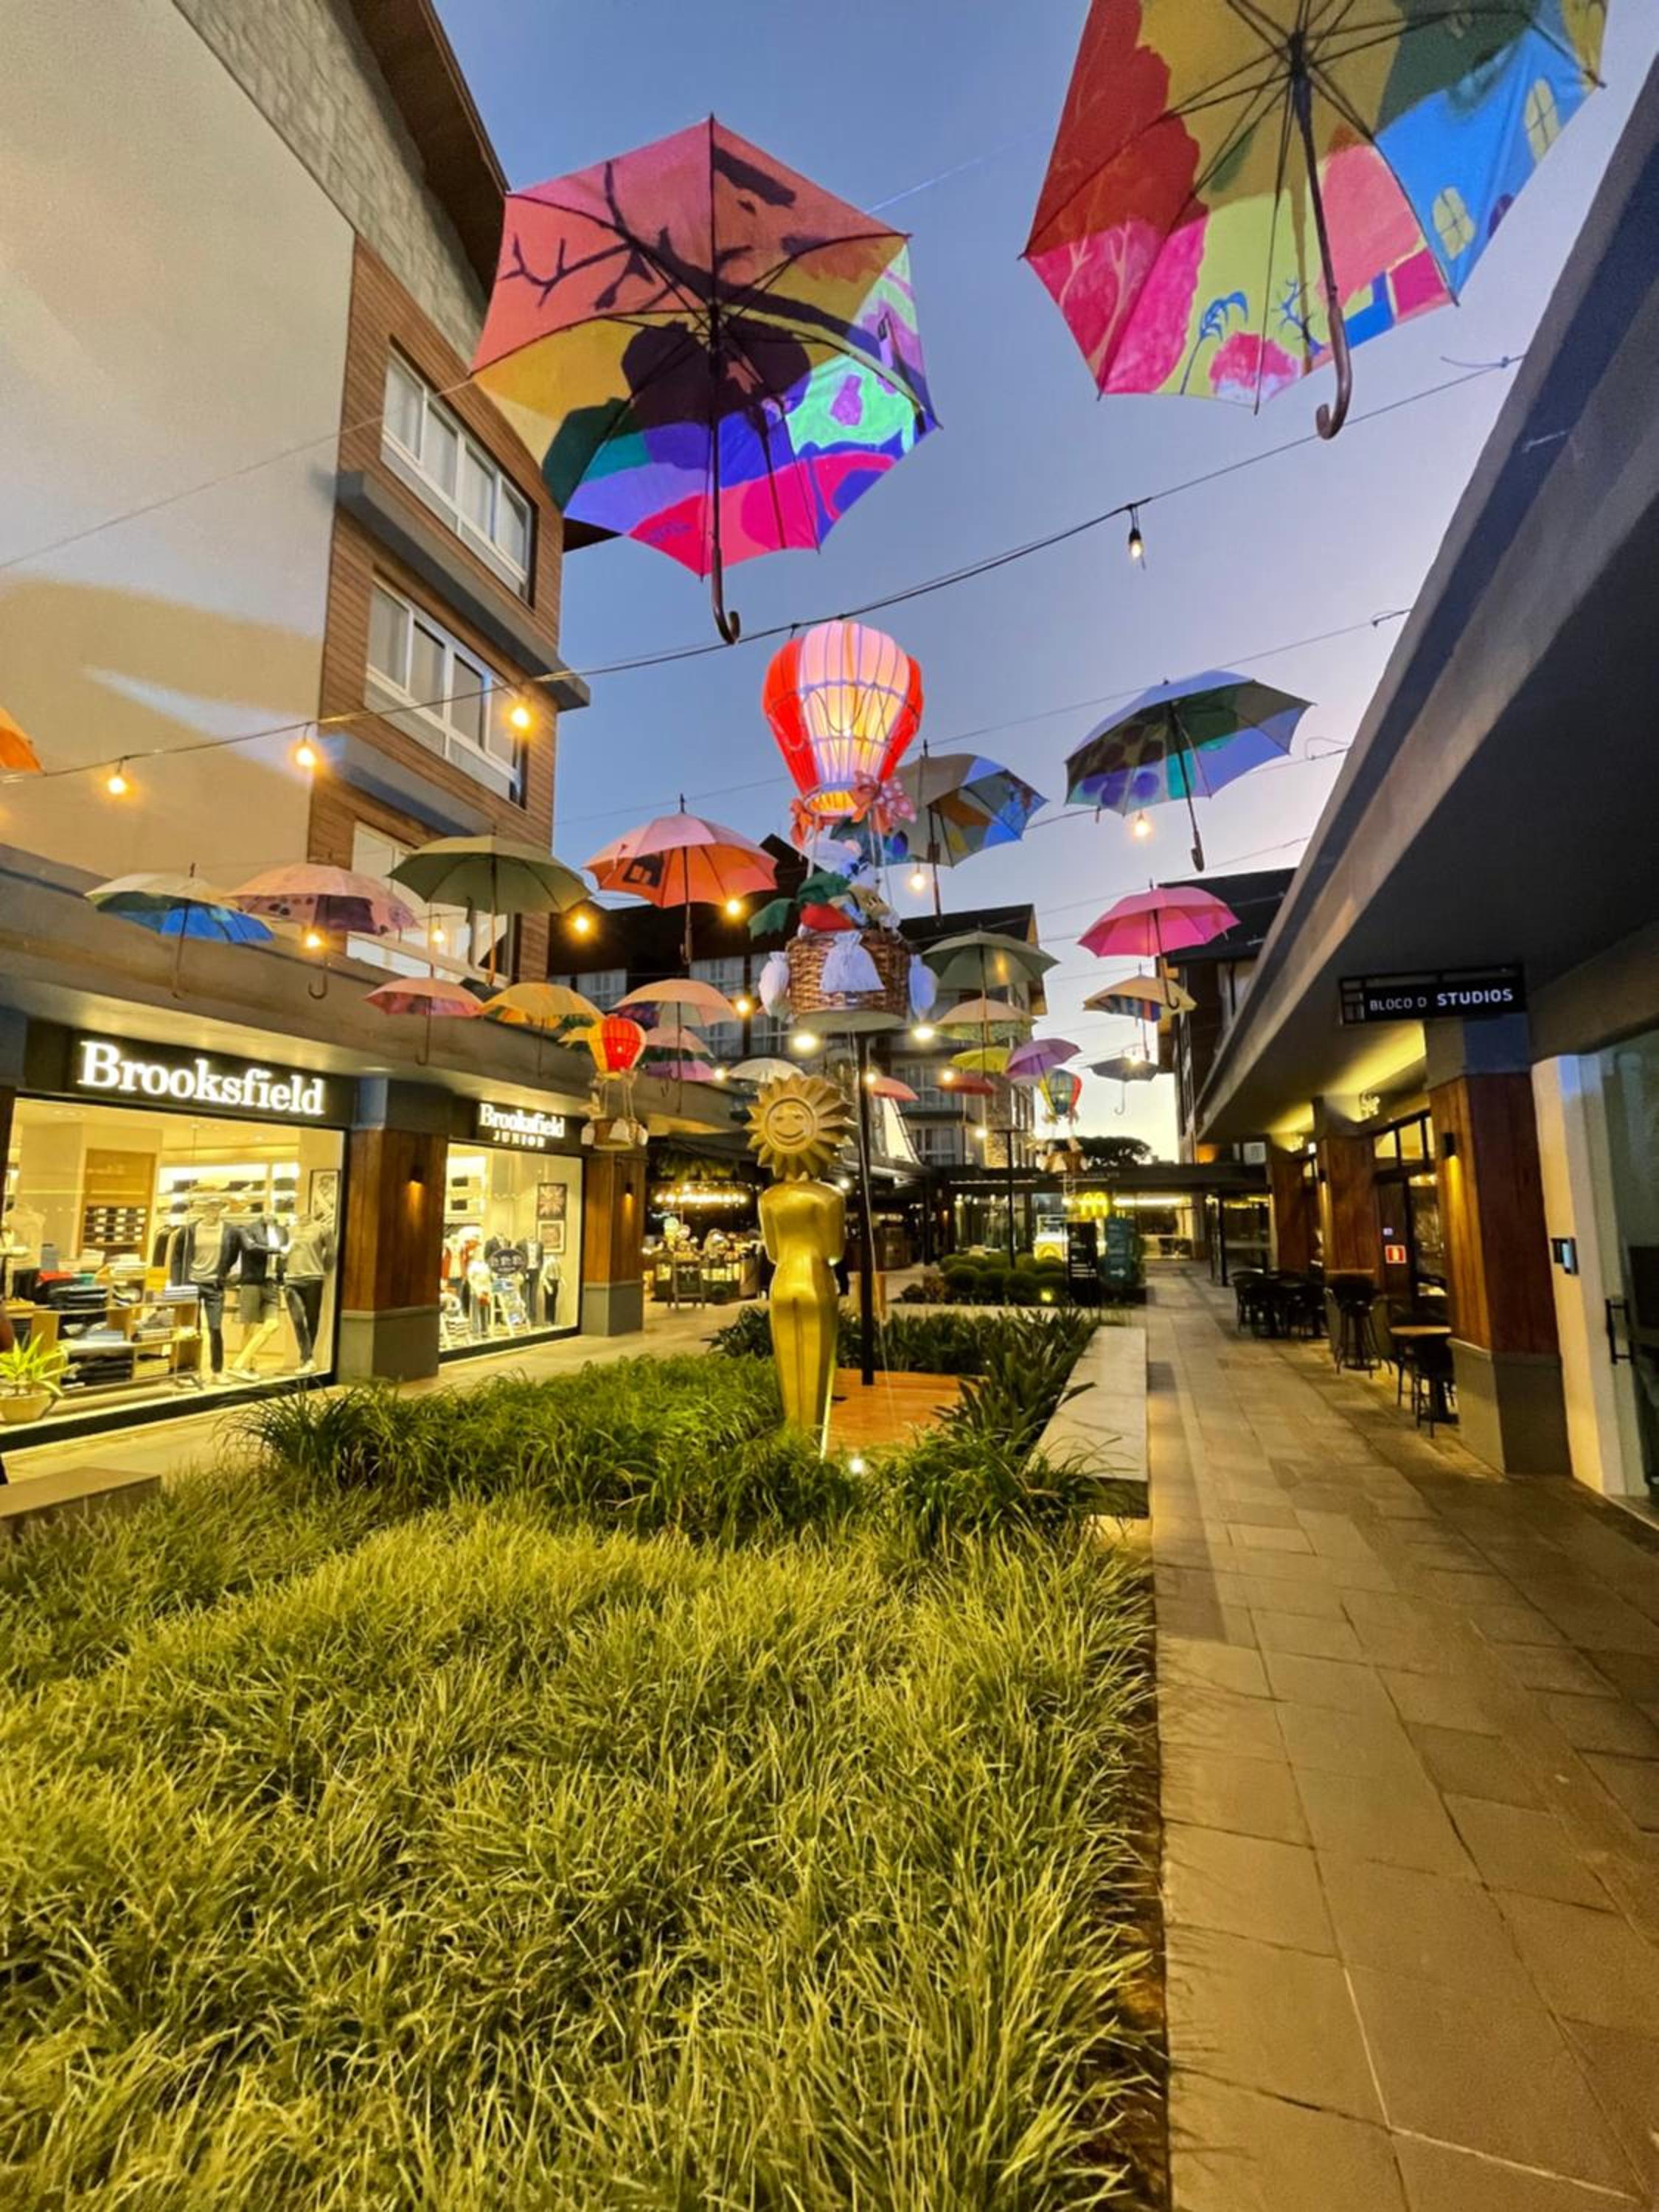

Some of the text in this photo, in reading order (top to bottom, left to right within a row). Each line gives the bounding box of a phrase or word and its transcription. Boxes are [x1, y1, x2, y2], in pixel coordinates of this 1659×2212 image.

[1369, 997, 1412, 1011] BLOCO
[1437, 988, 1513, 1006] STUDIOS
[77, 1040, 325, 1115] Brooksfield
[479, 1103, 565, 1138] Brooksfield
